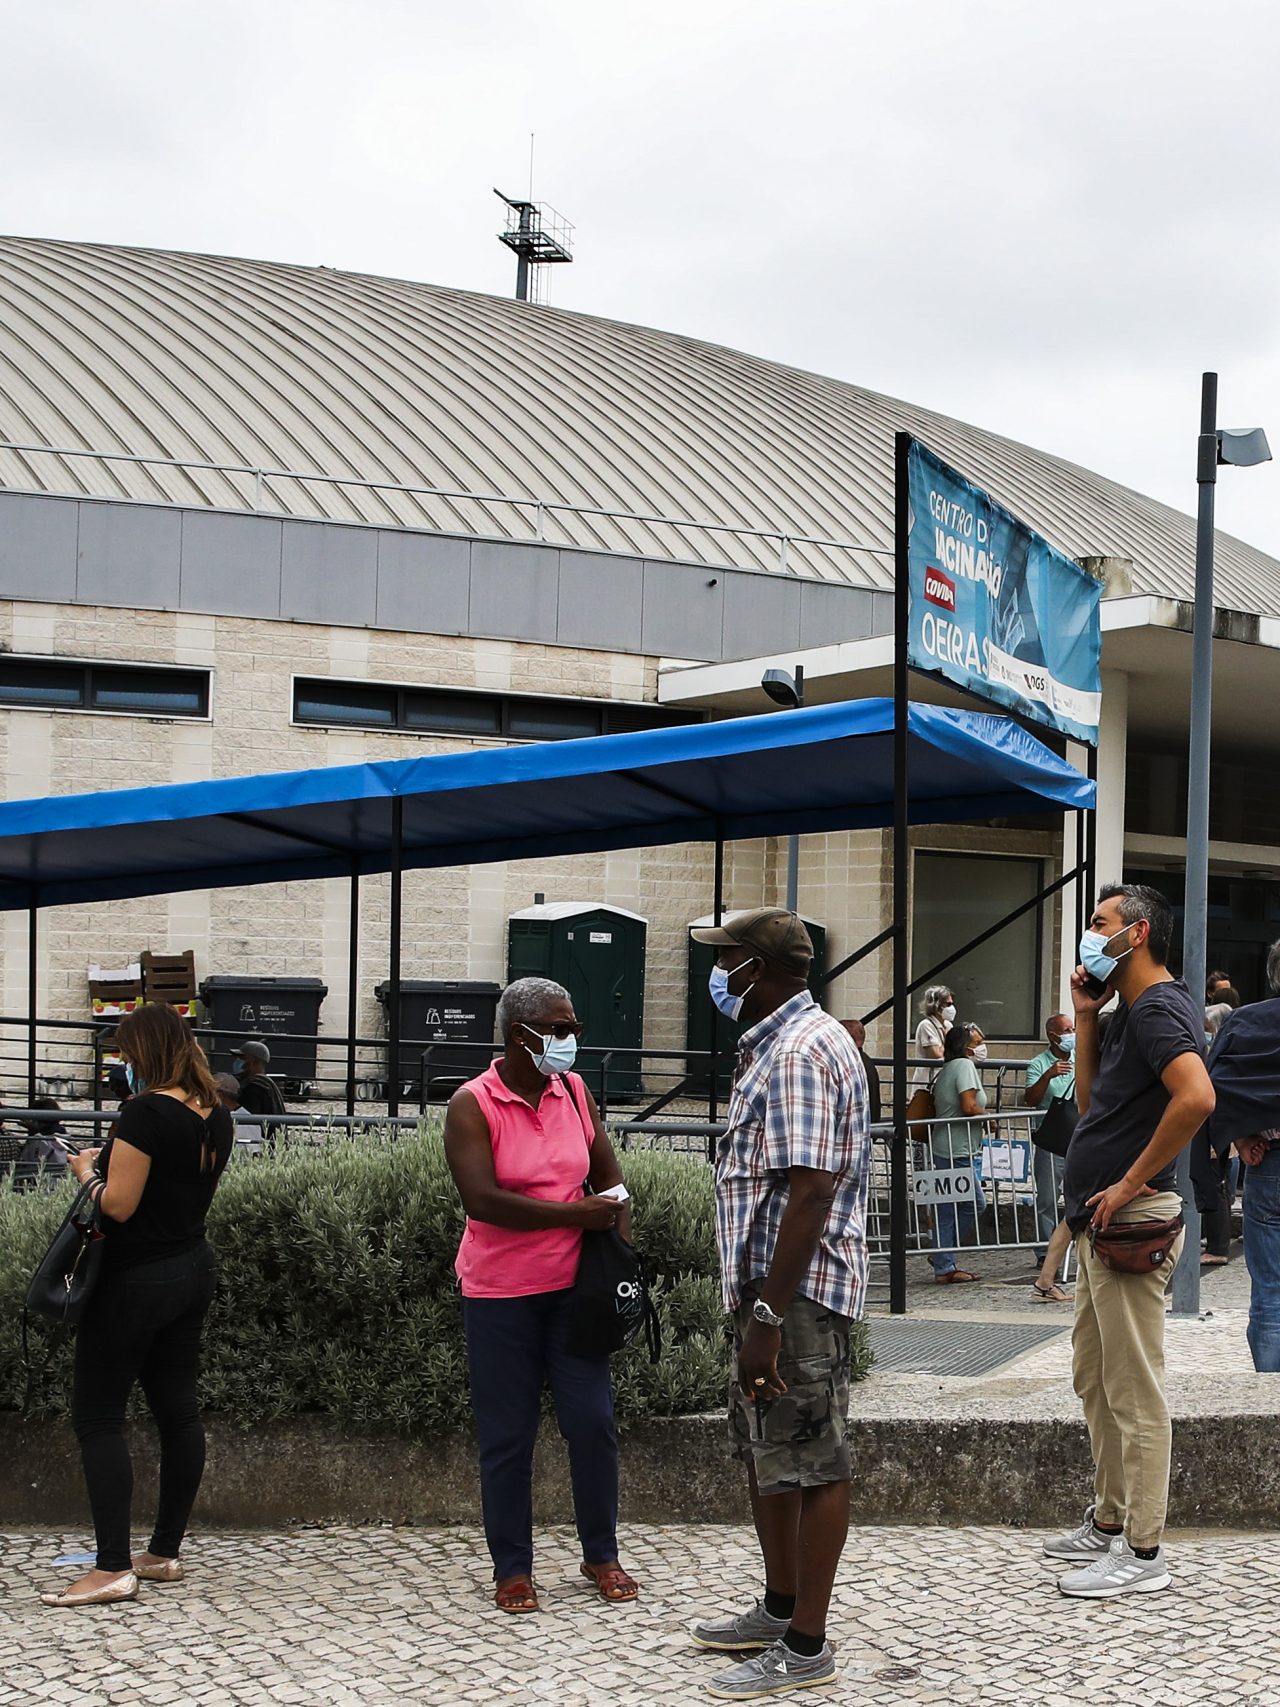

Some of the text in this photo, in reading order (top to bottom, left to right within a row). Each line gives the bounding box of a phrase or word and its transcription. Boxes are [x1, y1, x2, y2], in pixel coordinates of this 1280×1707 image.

[930, 490, 988, 547] CENTRO D
[921, 612, 989, 677] OEIRAS
[915, 1175, 971, 1196] CMO
